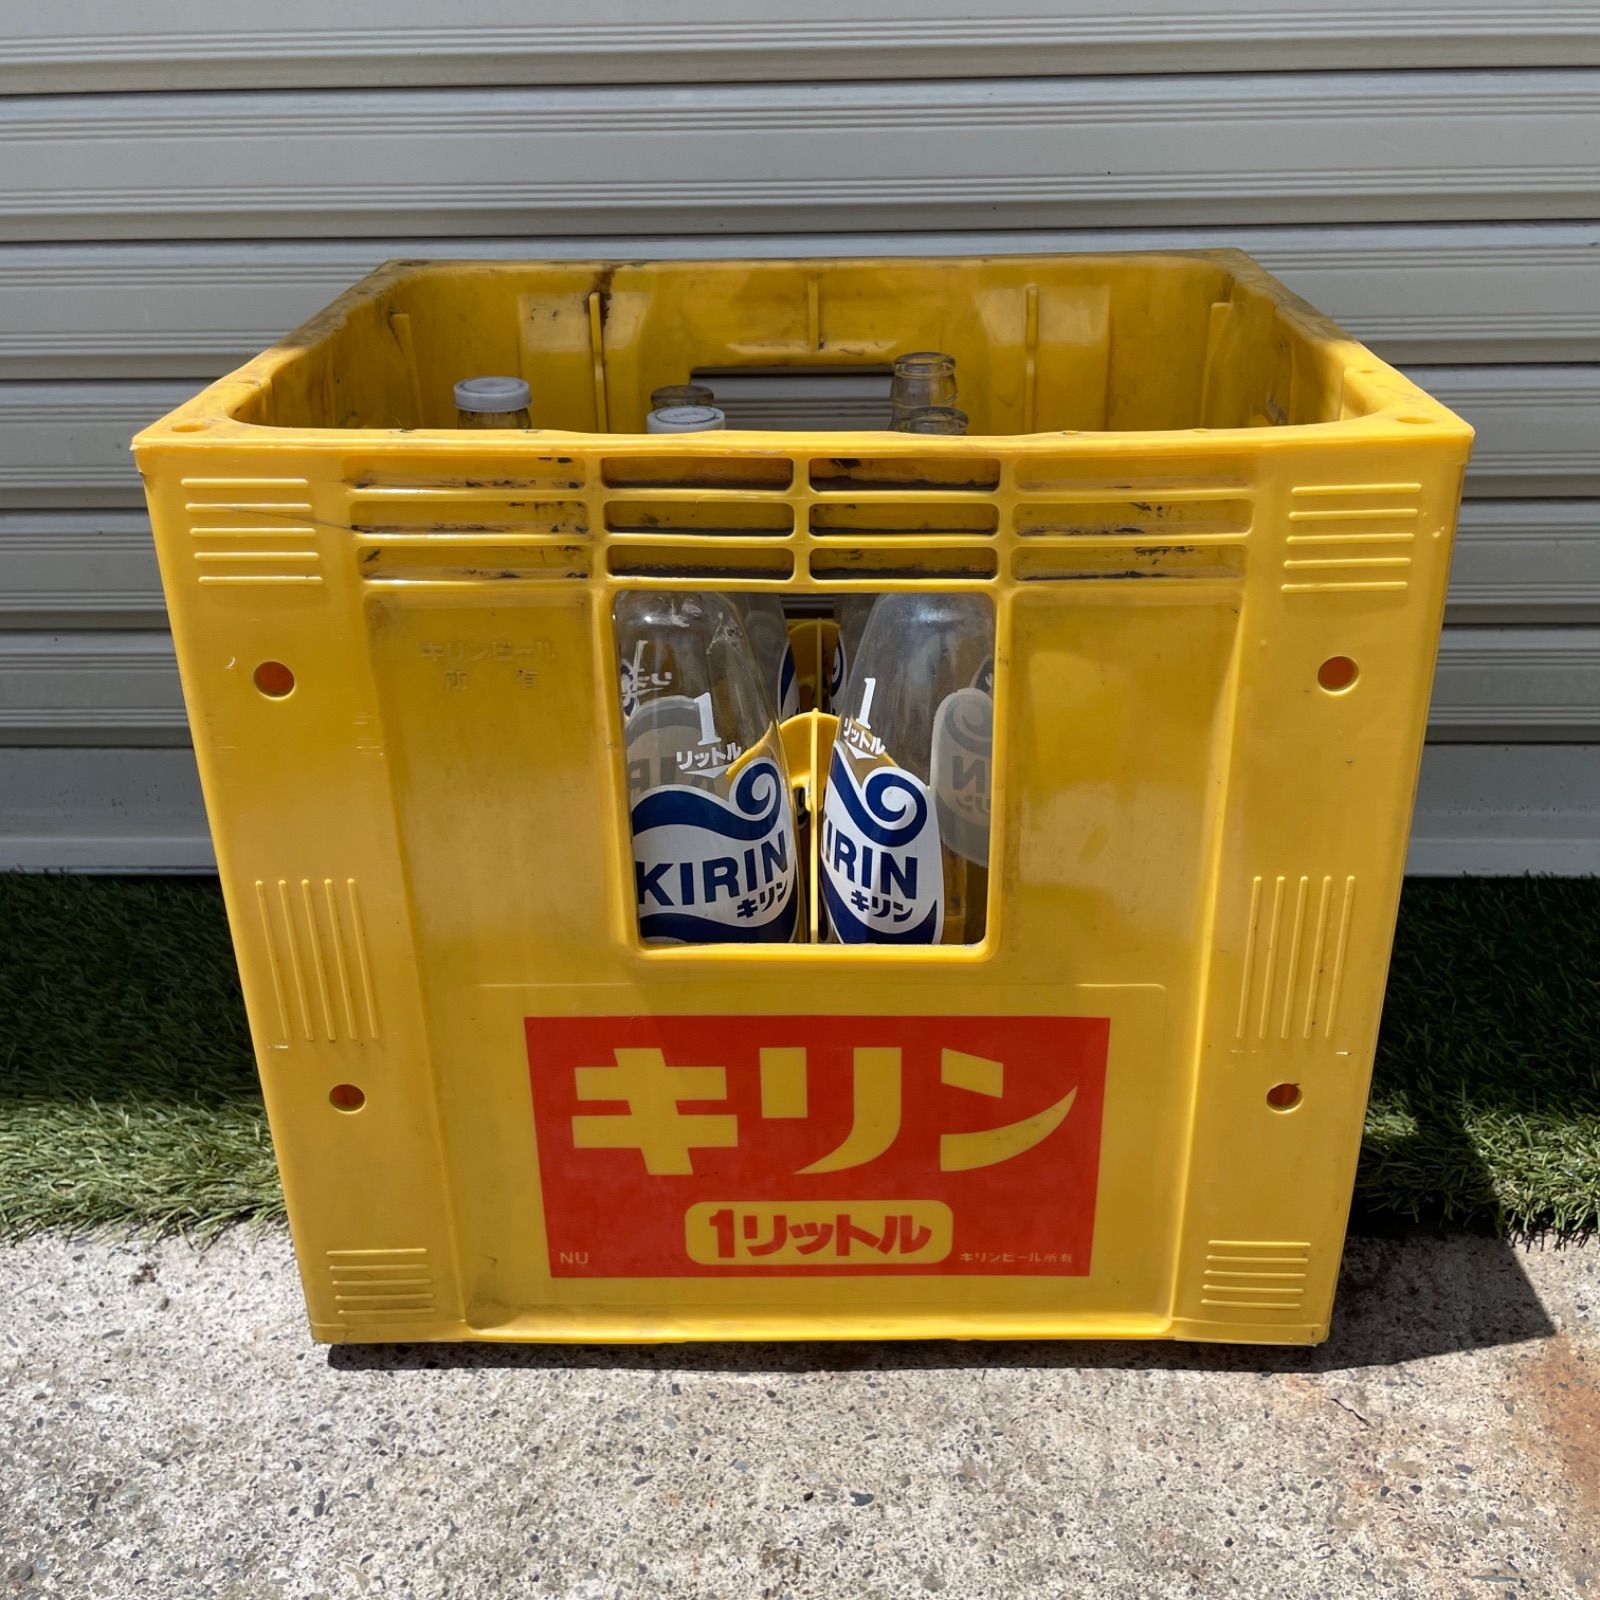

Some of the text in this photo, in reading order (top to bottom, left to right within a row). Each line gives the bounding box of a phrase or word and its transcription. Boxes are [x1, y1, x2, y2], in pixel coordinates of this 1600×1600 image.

[694, 692, 722, 745] 1
[855, 677, 876, 730] 1
[676, 742, 742, 770] リットル
[843, 717, 886, 755] リットル
[635, 829, 788, 906] KIRIN
[822, 818, 918, 900] IRIN
[737, 880, 788, 918] キリン
[851, 890, 913, 922] キリン
[572, 1047, 1078, 1175] キリン
[709, 1209, 931, 1258] 1リットル
[560, 1252, 588, 1265] NU
